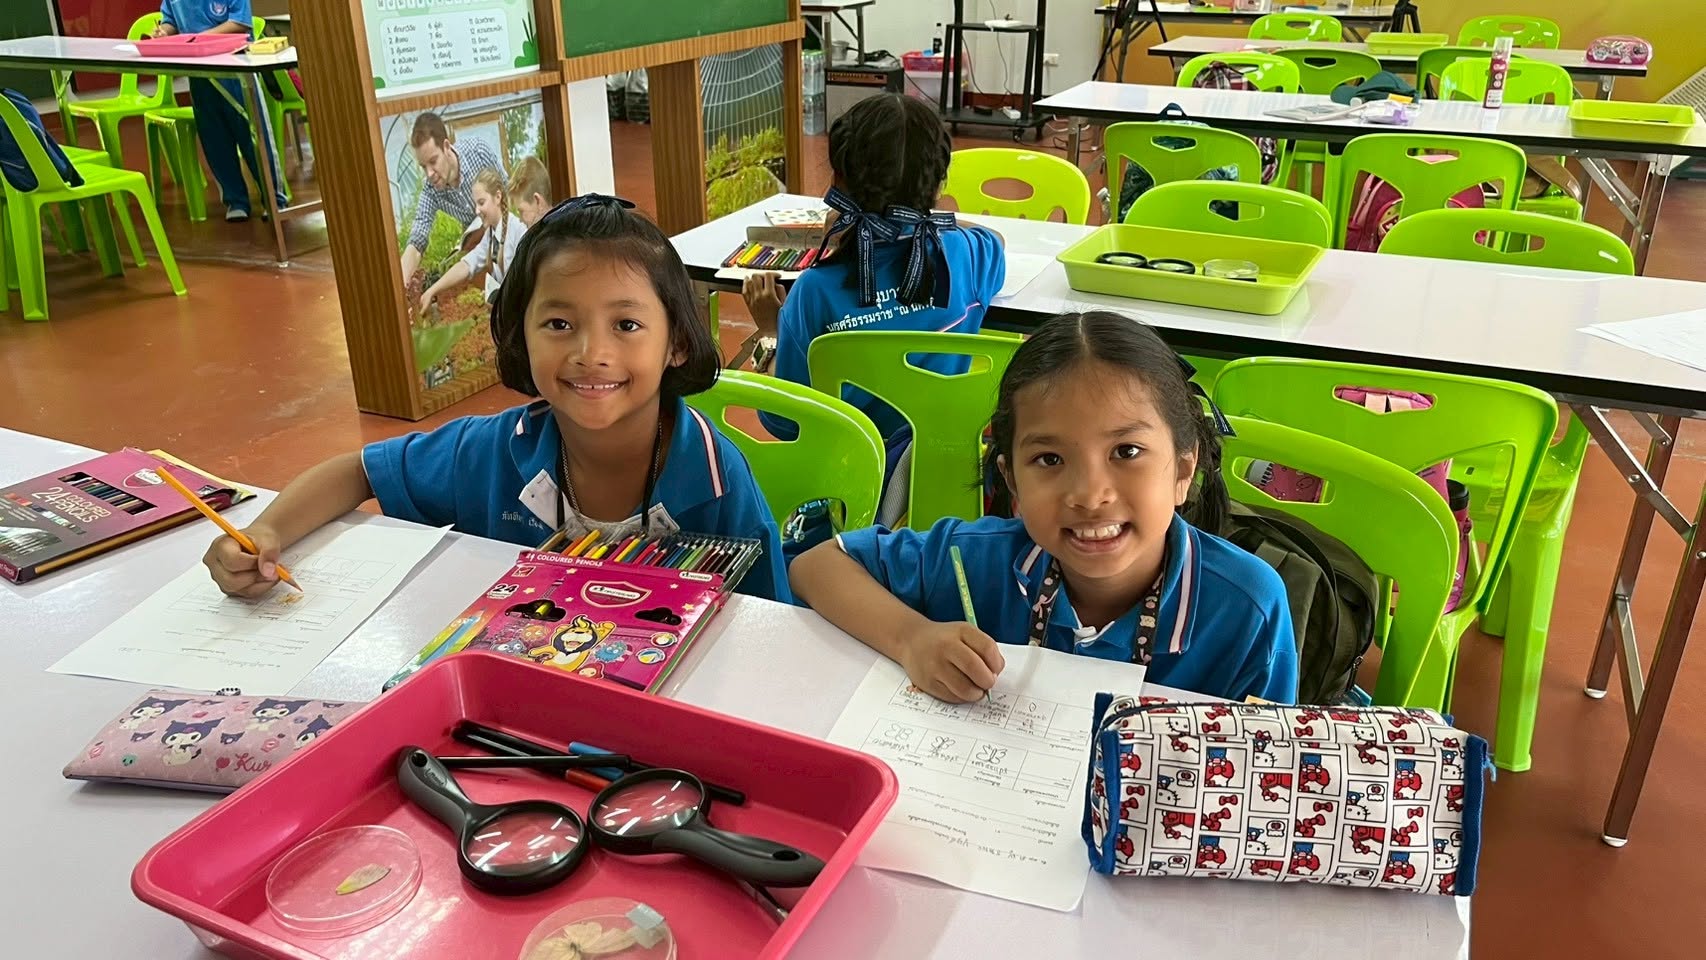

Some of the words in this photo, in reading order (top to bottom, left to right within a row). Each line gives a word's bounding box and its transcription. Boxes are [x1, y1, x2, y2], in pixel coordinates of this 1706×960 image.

[56, 498, 99, 523] PENCILS
[66, 494, 111, 518] COLOURED
[536, 554, 573, 564] COLOURED
[575, 559, 603, 567] PENCILS
[492, 584, 518, 593] 24
[234, 752, 272, 772] Kur
